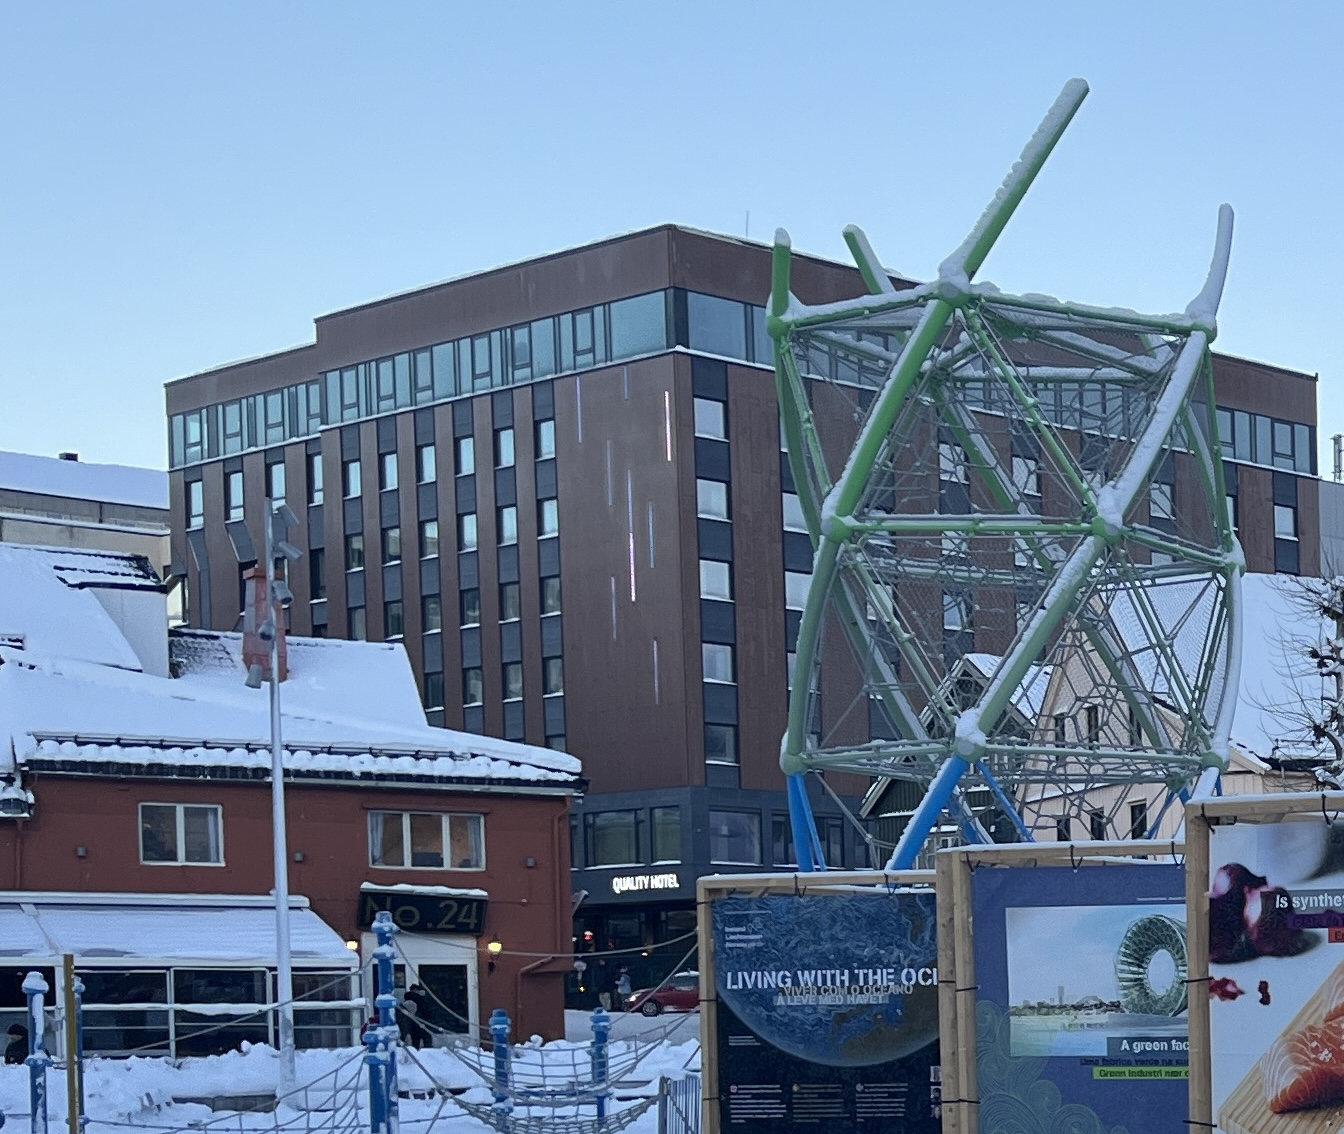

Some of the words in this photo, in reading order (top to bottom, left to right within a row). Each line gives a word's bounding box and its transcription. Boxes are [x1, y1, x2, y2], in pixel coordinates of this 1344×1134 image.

[612, 875, 649, 893] QUALITY
[650, 873, 680, 889] HOTEL
[1275, 893, 1288, 909] Is
[1334, 930, 1344, 941] Er
[726, 970, 792, 990] LIVING
[797, 969, 849, 988] WITH
[854, 968, 895, 987] THE
[1120, 1039, 1130, 1051] A
[1132, 1041, 1168, 1054] green
